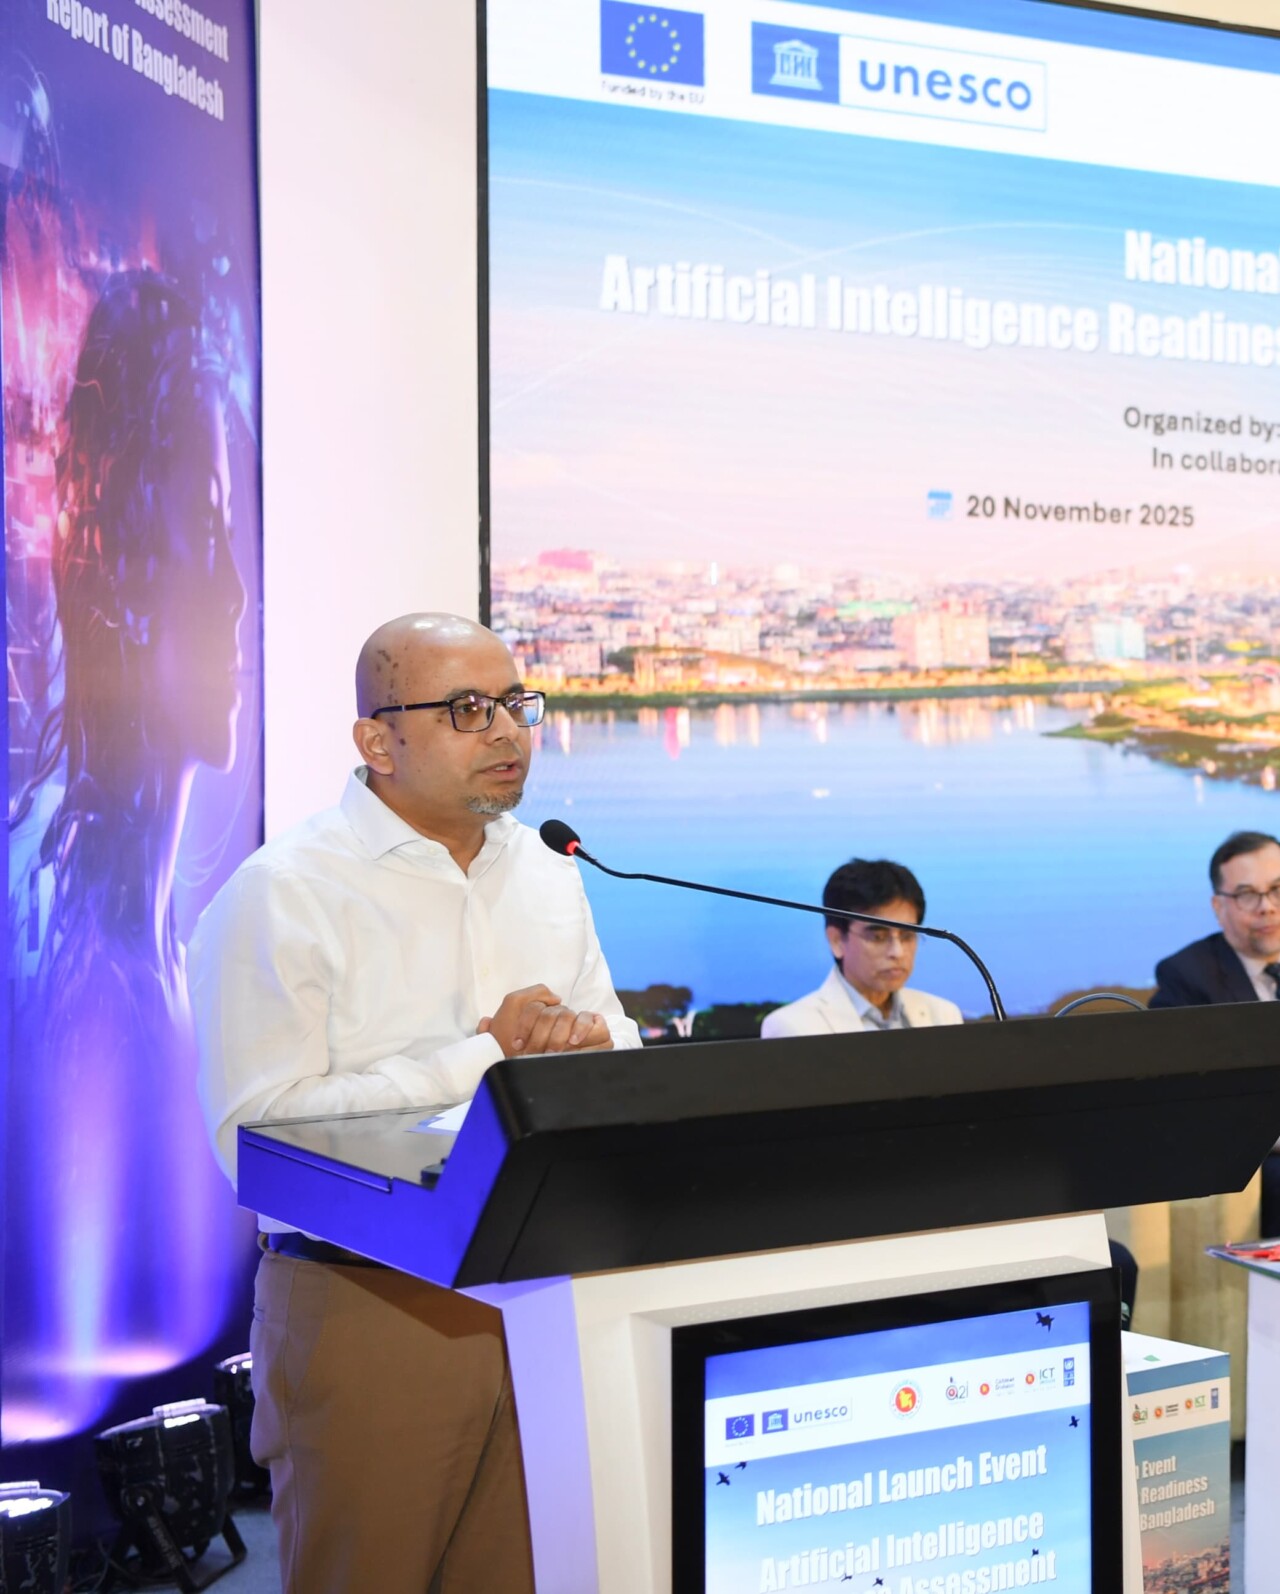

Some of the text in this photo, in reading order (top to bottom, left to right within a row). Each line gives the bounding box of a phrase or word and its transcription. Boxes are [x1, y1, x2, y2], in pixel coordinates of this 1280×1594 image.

[135, 0, 229, 62] sessment
[112, 23, 129, 65] of
[131, 28, 224, 122] Bangladesh
[859, 59, 1032, 112] unesco
[599, 254, 816, 329] Artificial
[827, 275, 1100, 352] Intelligence
[1123, 406, 1242, 436] Organized
[1152, 447, 1174, 469] In
[966, 495, 1195, 527] 20 November 2025
[1039, 1367, 1055, 1380] ICT
[793, 1405, 848, 1424] unesco
[1142, 1455, 1176, 1478] Event
[756, 1444, 1047, 1526] National Launch Event
[1141, 1476, 1208, 1505] Readiness
[1140, 1498, 1215, 1532] Bangladesh
[758, 1511, 1044, 1594] Artificial Intelligence
